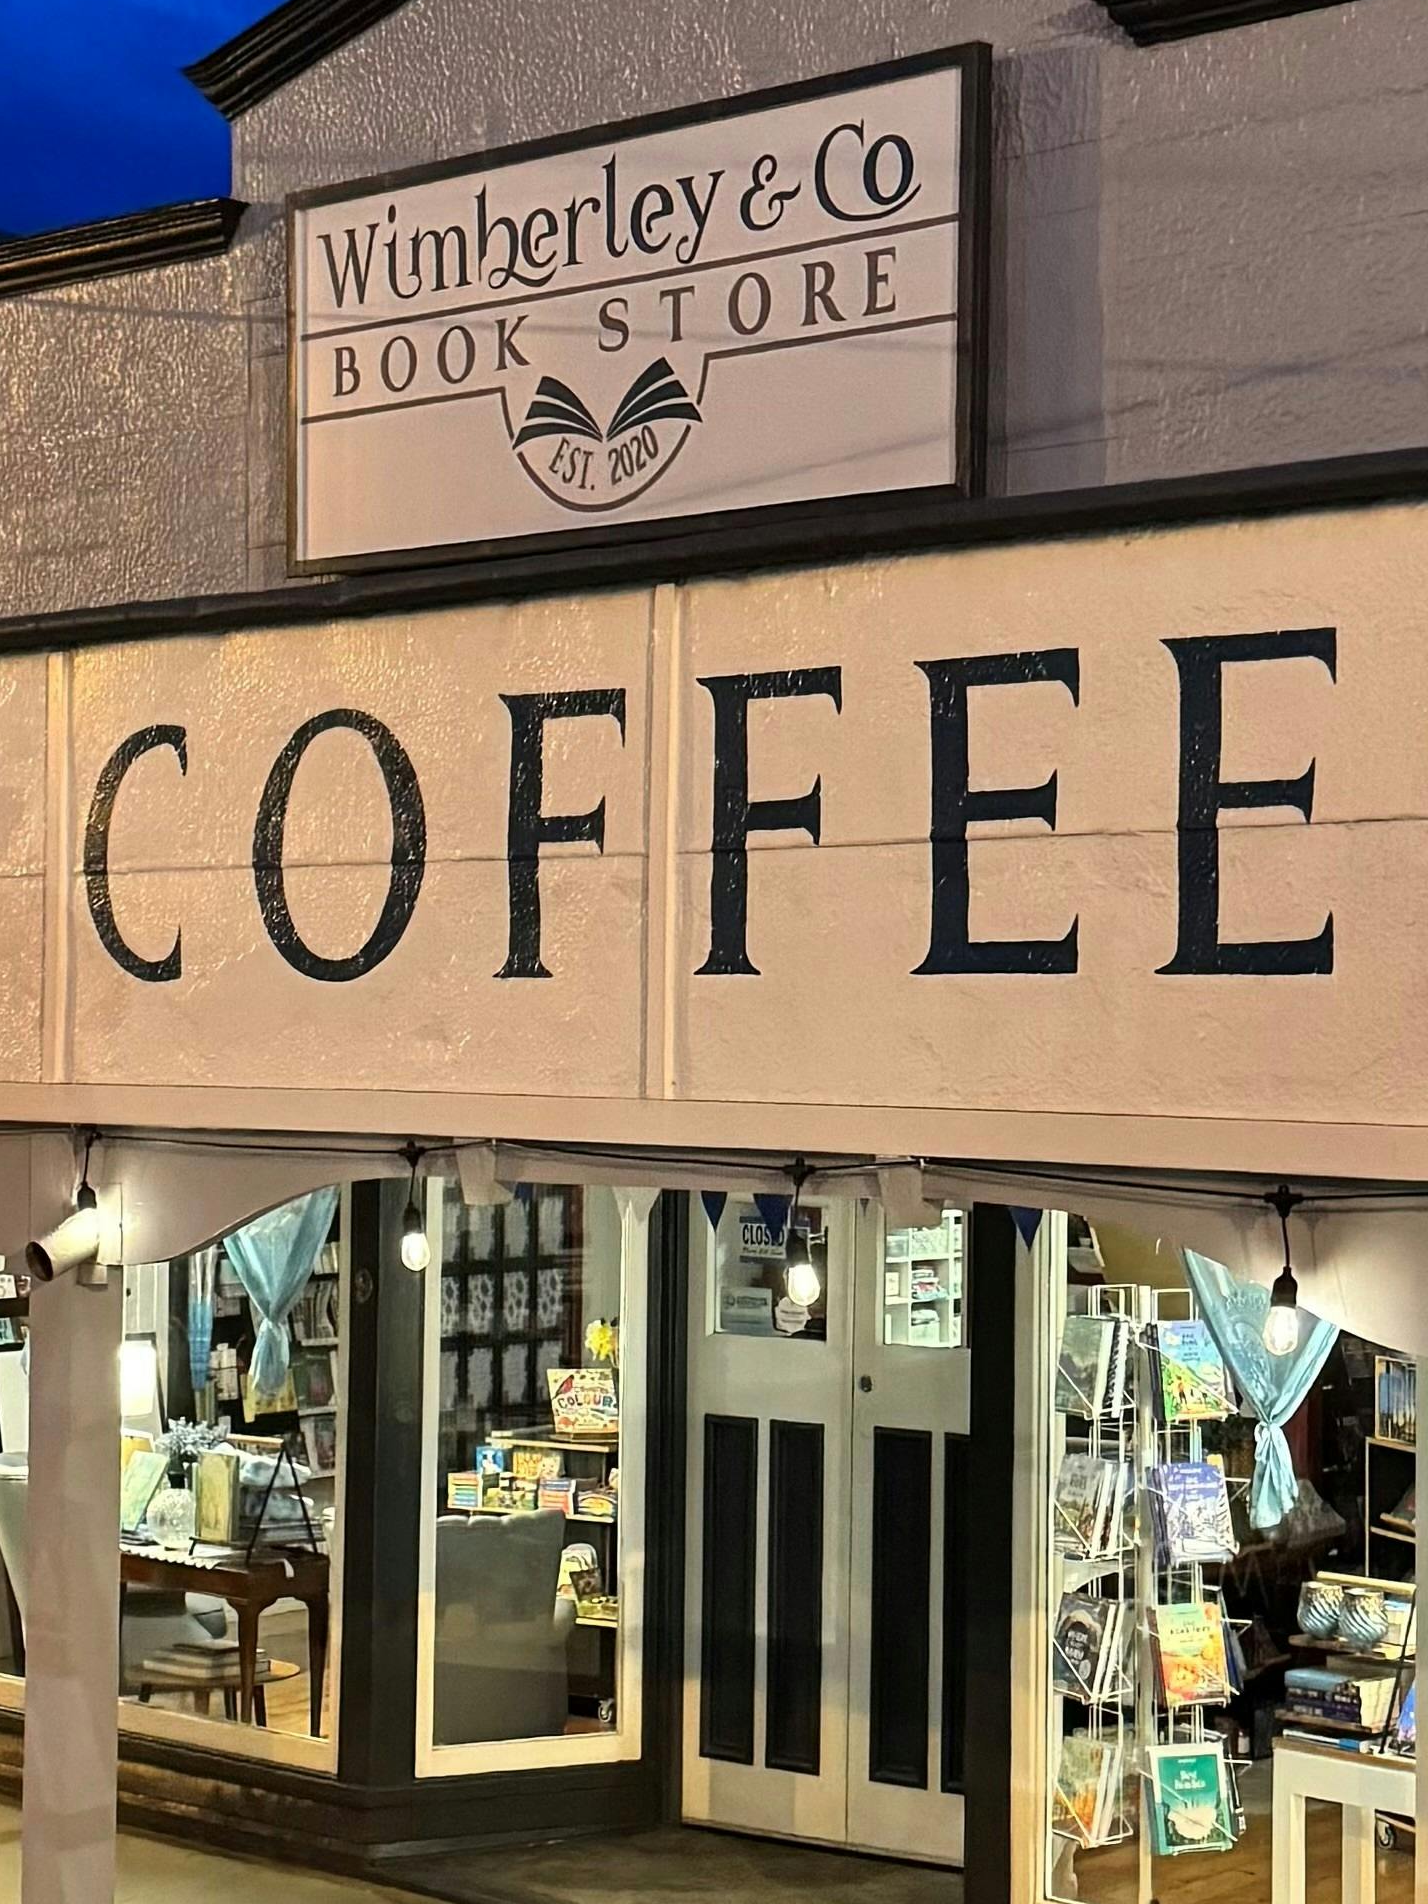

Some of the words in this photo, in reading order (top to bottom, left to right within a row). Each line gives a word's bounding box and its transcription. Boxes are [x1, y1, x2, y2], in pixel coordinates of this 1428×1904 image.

[316, 152, 725, 309] Wimberley
[740, 154, 800, 228] &
[813, 117, 922, 222] Co
[332, 313, 532, 398] BOOK
[597, 245, 898, 353] STORE
[548, 436, 596, 492] EST.
[608, 423, 660, 487] 2020
[83, 626, 1338, 983] COFFEE
